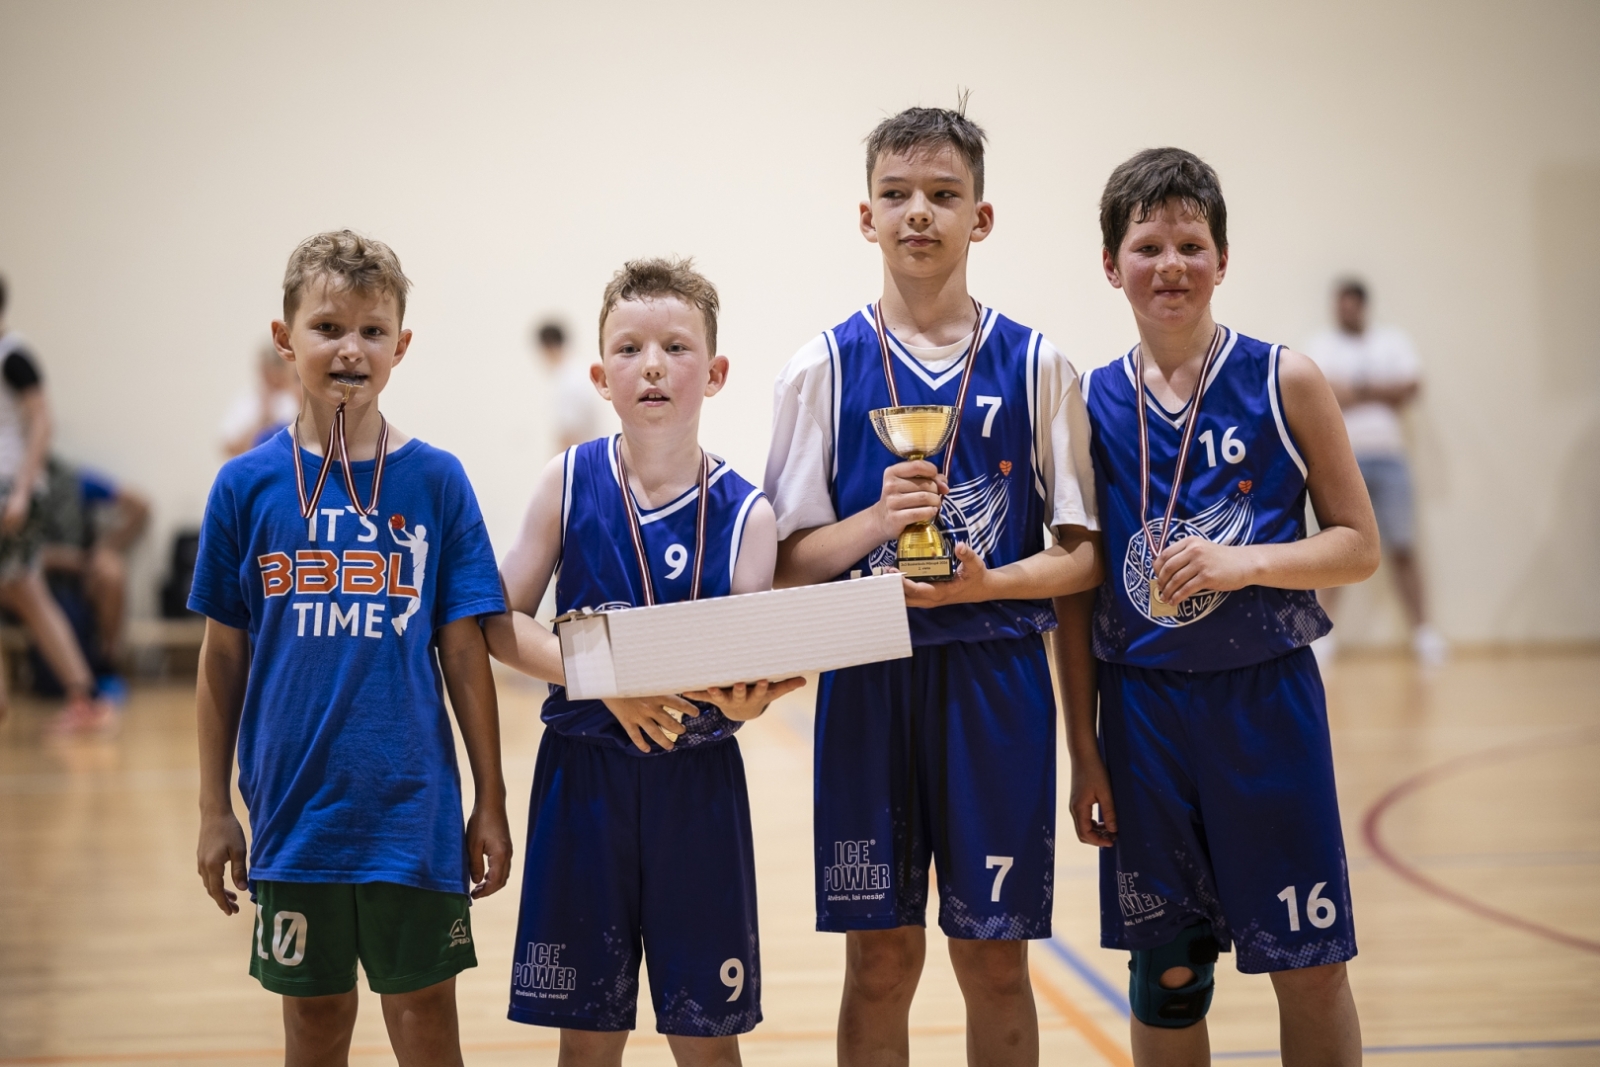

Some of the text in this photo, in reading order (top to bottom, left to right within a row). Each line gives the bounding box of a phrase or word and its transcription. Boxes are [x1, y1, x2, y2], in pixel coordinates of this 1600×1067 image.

[976, 395, 1002, 438] 7
[1198, 426, 1246, 468] 16
[257, 550, 420, 599] BBBL
[664, 543, 688, 580] 9
[292, 602, 386, 639] TIME
[824, 864, 891, 892] POWER
[985, 855, 1014, 902] 7
[1276, 881, 1336, 932] 16
[513, 962, 577, 991] POWER
[719, 957, 745, 1003] 9
